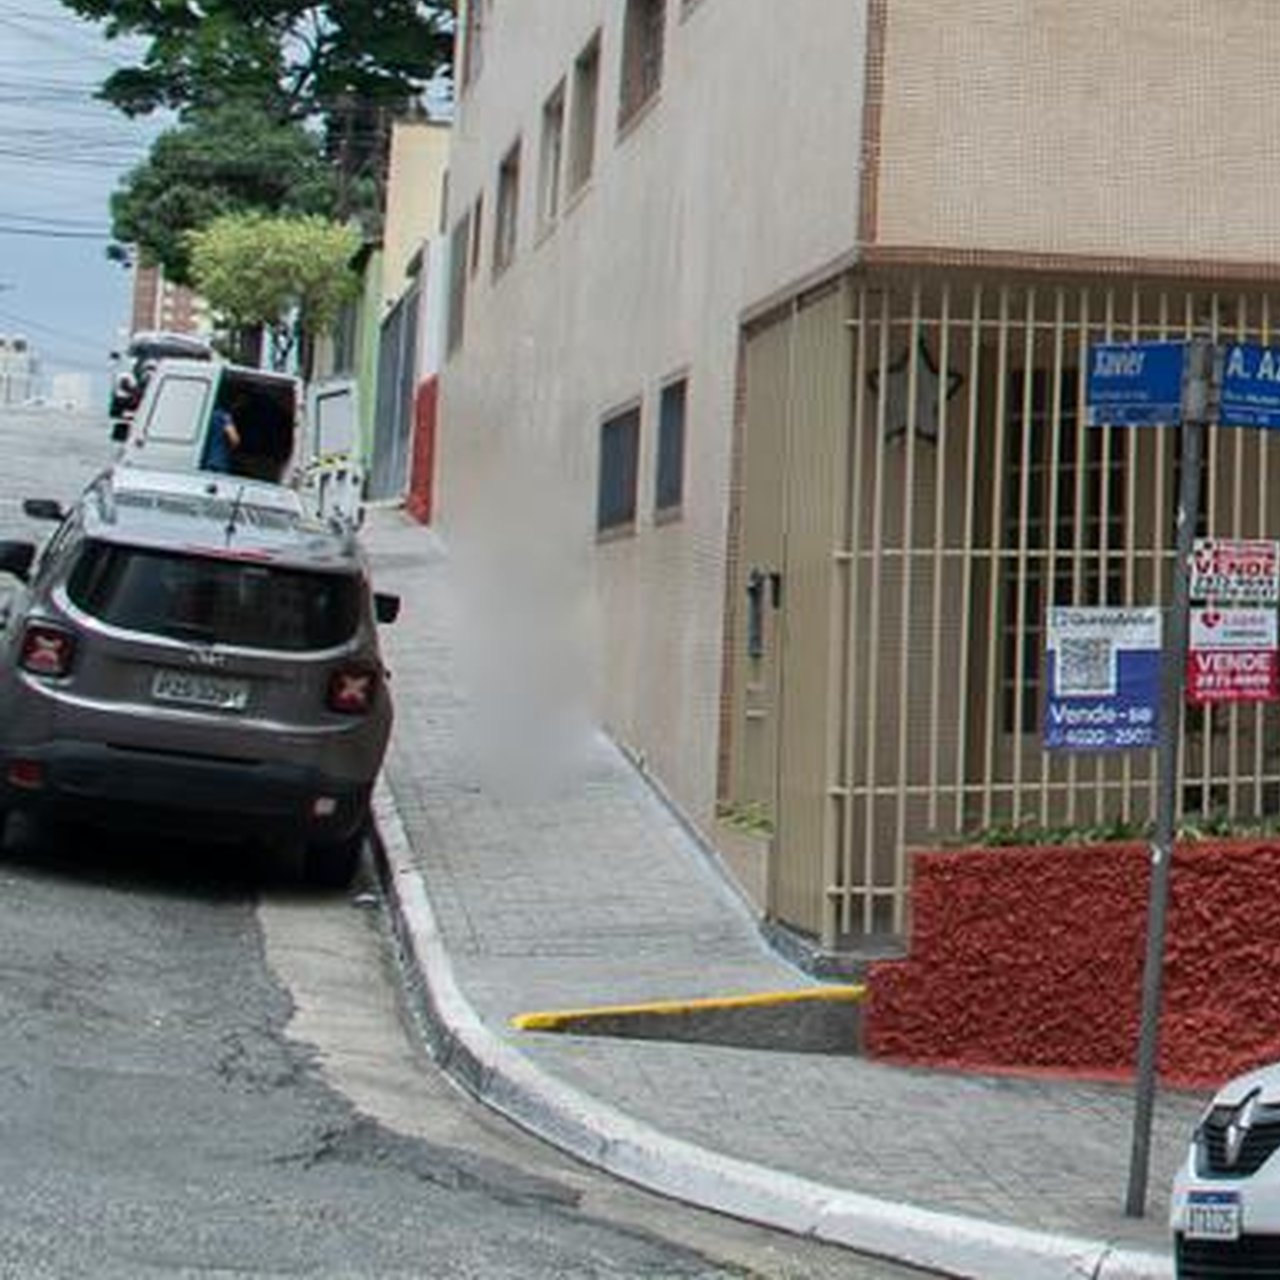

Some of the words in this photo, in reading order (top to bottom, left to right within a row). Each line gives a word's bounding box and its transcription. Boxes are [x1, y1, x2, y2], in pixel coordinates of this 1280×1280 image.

[1226, 346, 1251, 379] A.
[1196, 652, 1270, 672] VENDE
[1050, 703, 1153, 724] Vende-se
